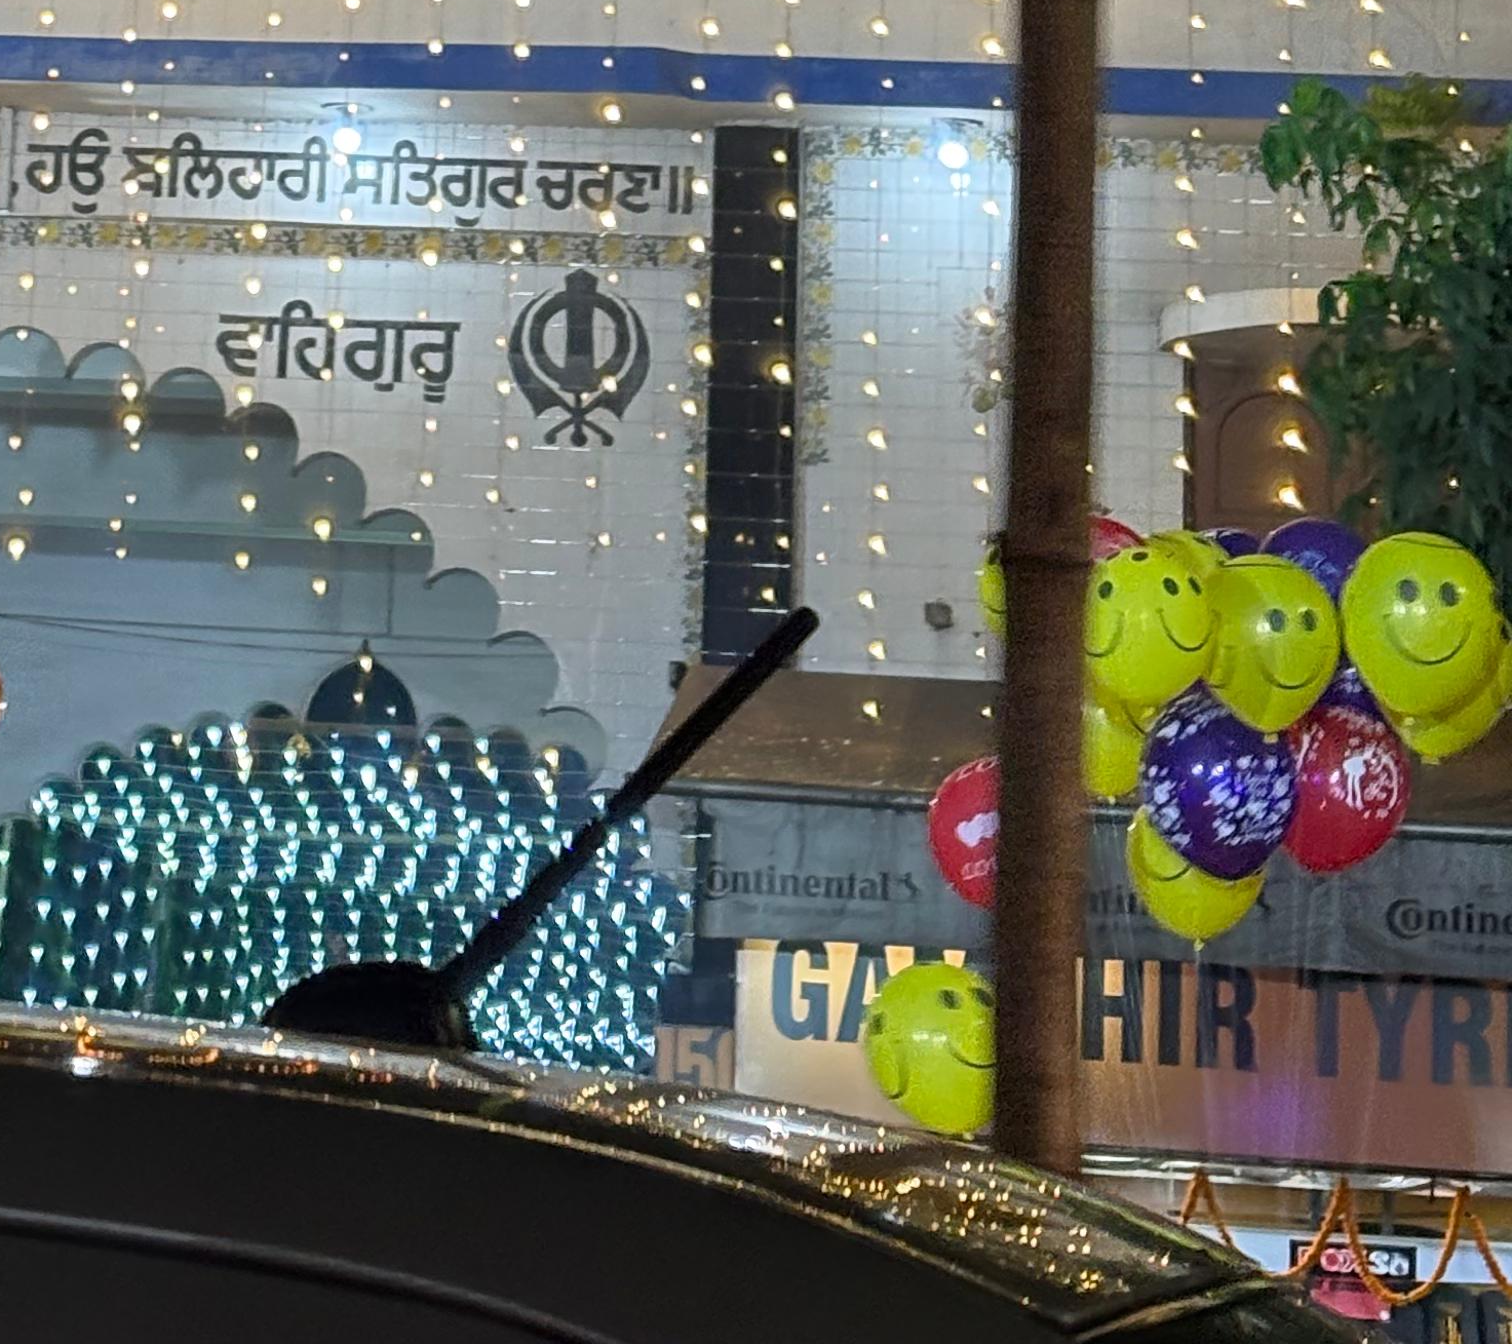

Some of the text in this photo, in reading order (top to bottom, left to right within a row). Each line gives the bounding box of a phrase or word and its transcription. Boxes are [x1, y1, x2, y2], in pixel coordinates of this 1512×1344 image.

[122, 132, 330, 202] ਬਲਿਹਾਰੀ
[343, 140, 528, 227] ਸਤਿਗੁਰ
[216, 299, 462, 403] ਵਾਹਿਗੁਰੂ
